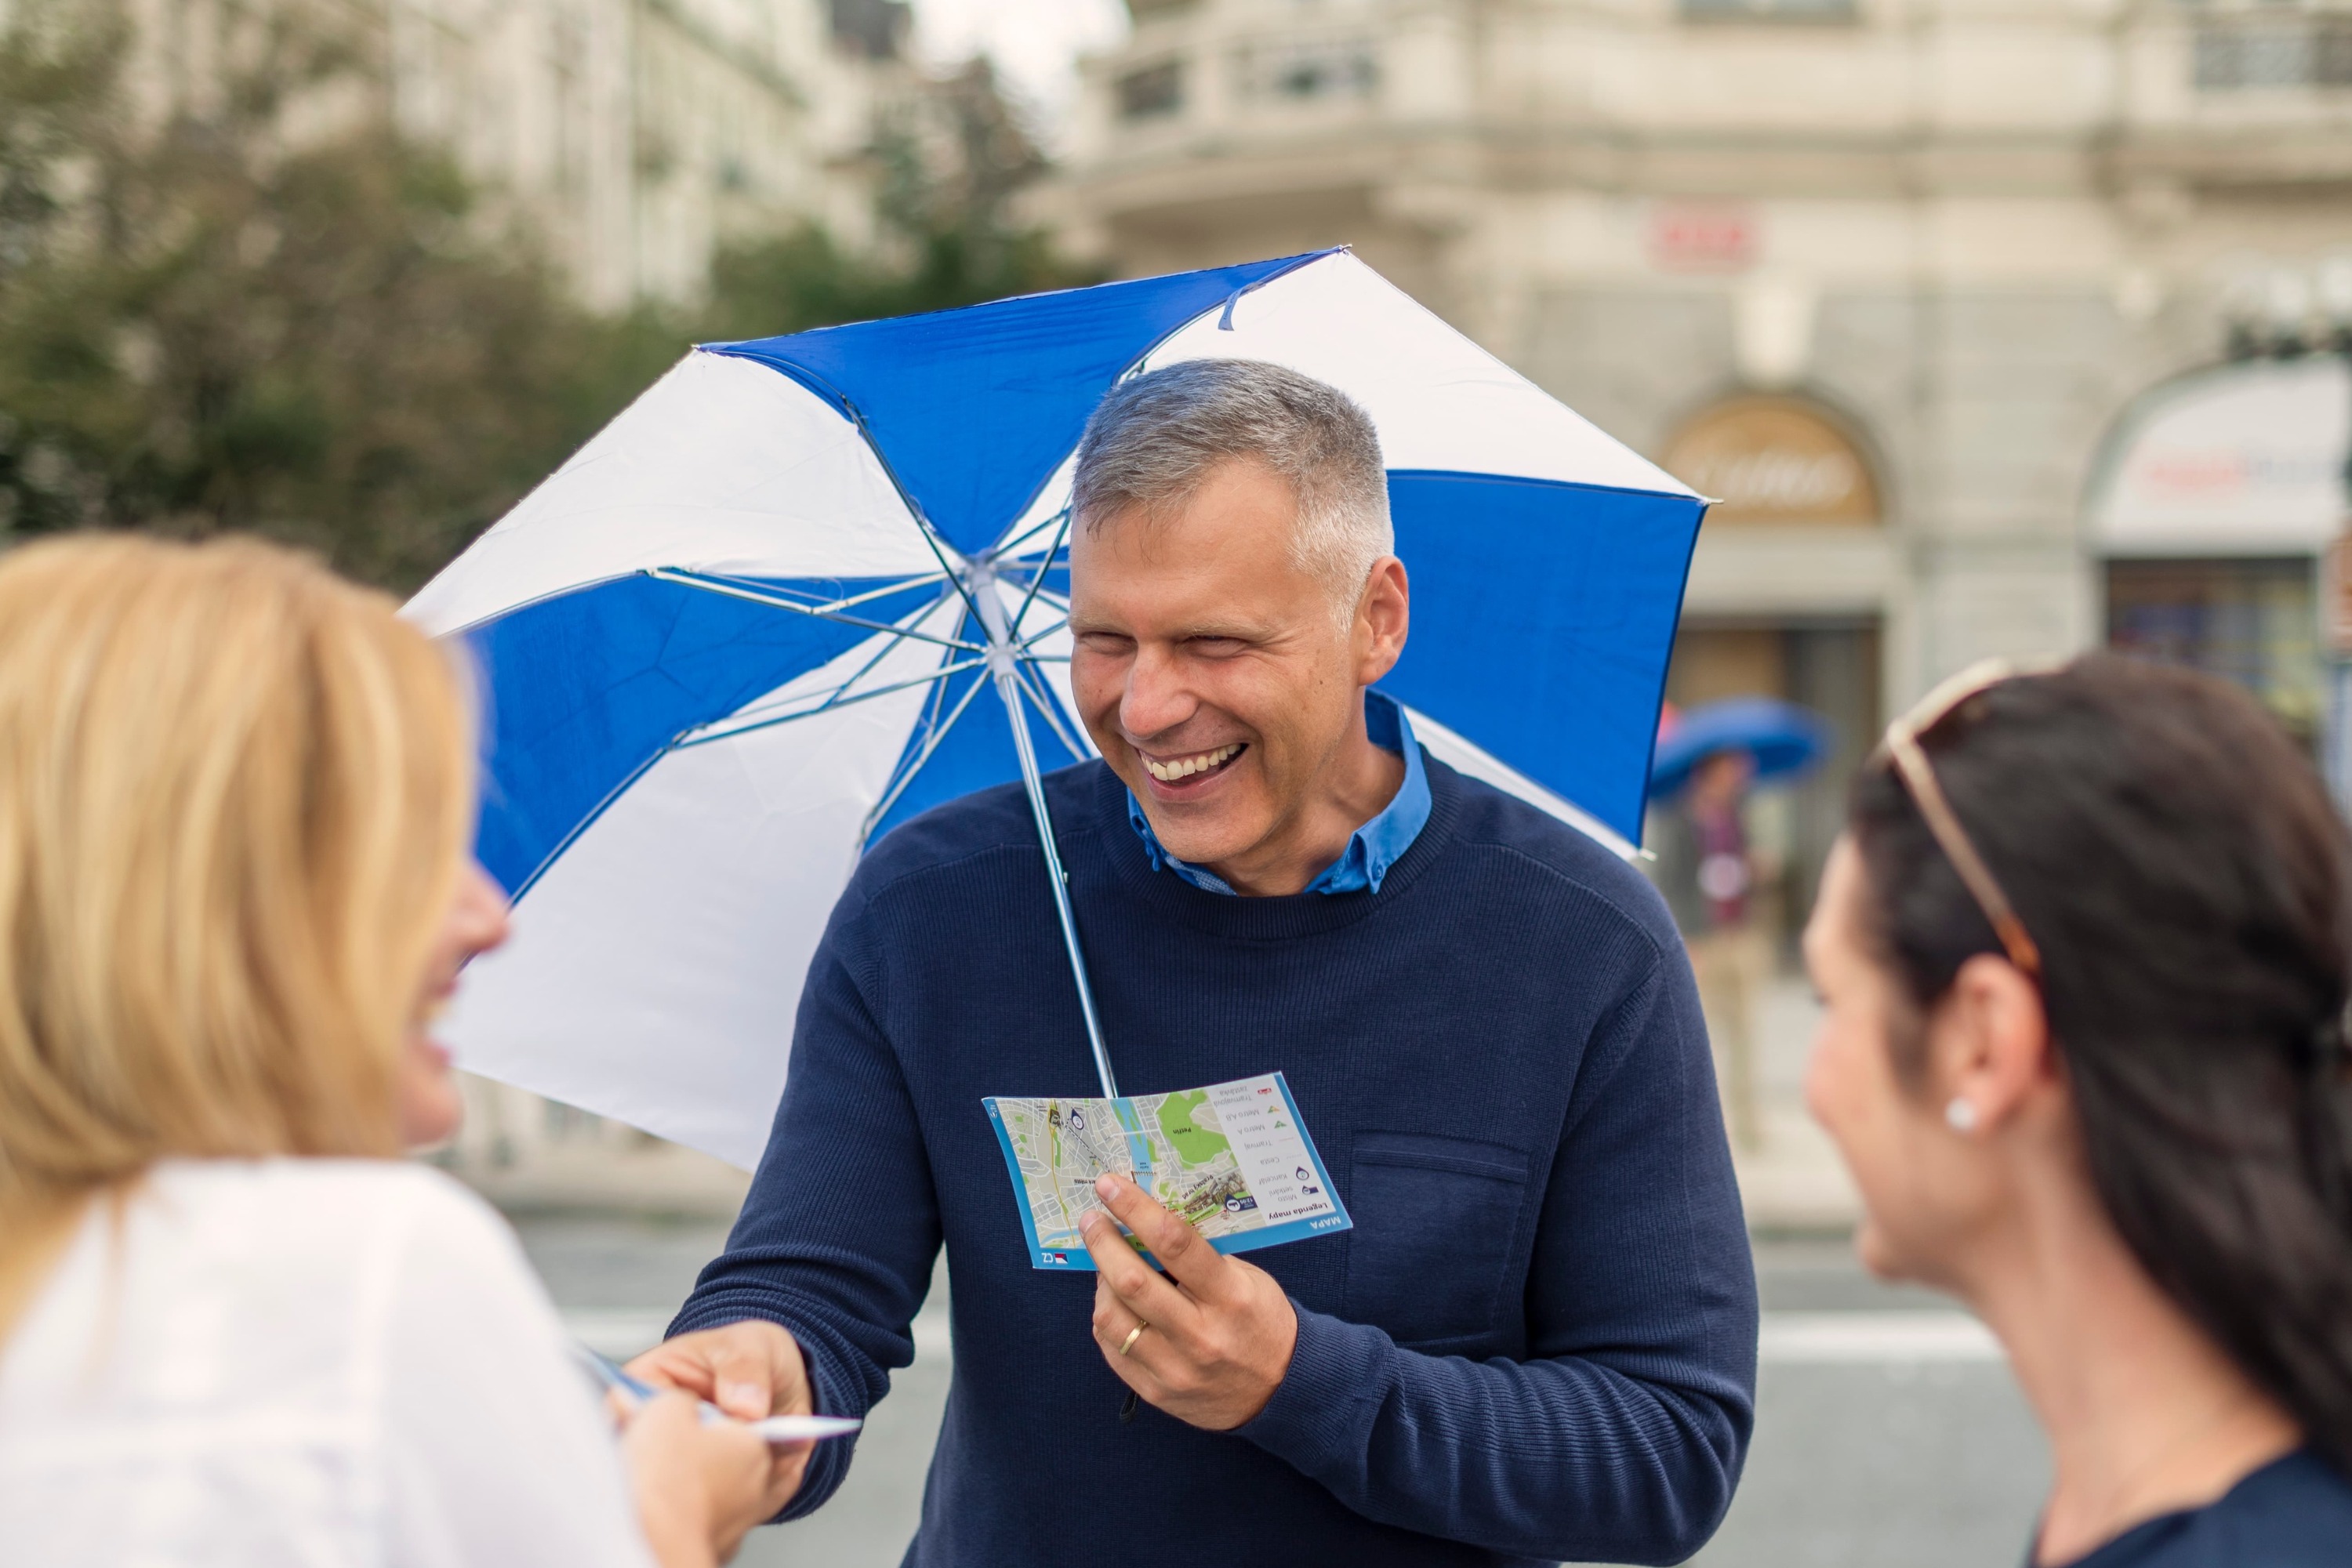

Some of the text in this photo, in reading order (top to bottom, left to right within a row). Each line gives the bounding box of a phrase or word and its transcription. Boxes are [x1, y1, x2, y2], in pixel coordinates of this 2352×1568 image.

[1238, 1109, 1260, 1118] Metro
[1243, 1123, 1265, 1133] Metro
[1244, 1140, 1272, 1151] Tramvaj
[1260, 1156, 1280, 1165] Cesta
[1259, 1174, 1287, 1185] Kancelář
[1181, 1174, 1214, 1200] Pražský hrad
[1269, 1203, 1328, 1220] Legenda mapy
[1309, 1216, 1341, 1229] MAPA
[1041, 1253, 1054, 1263] CZ
